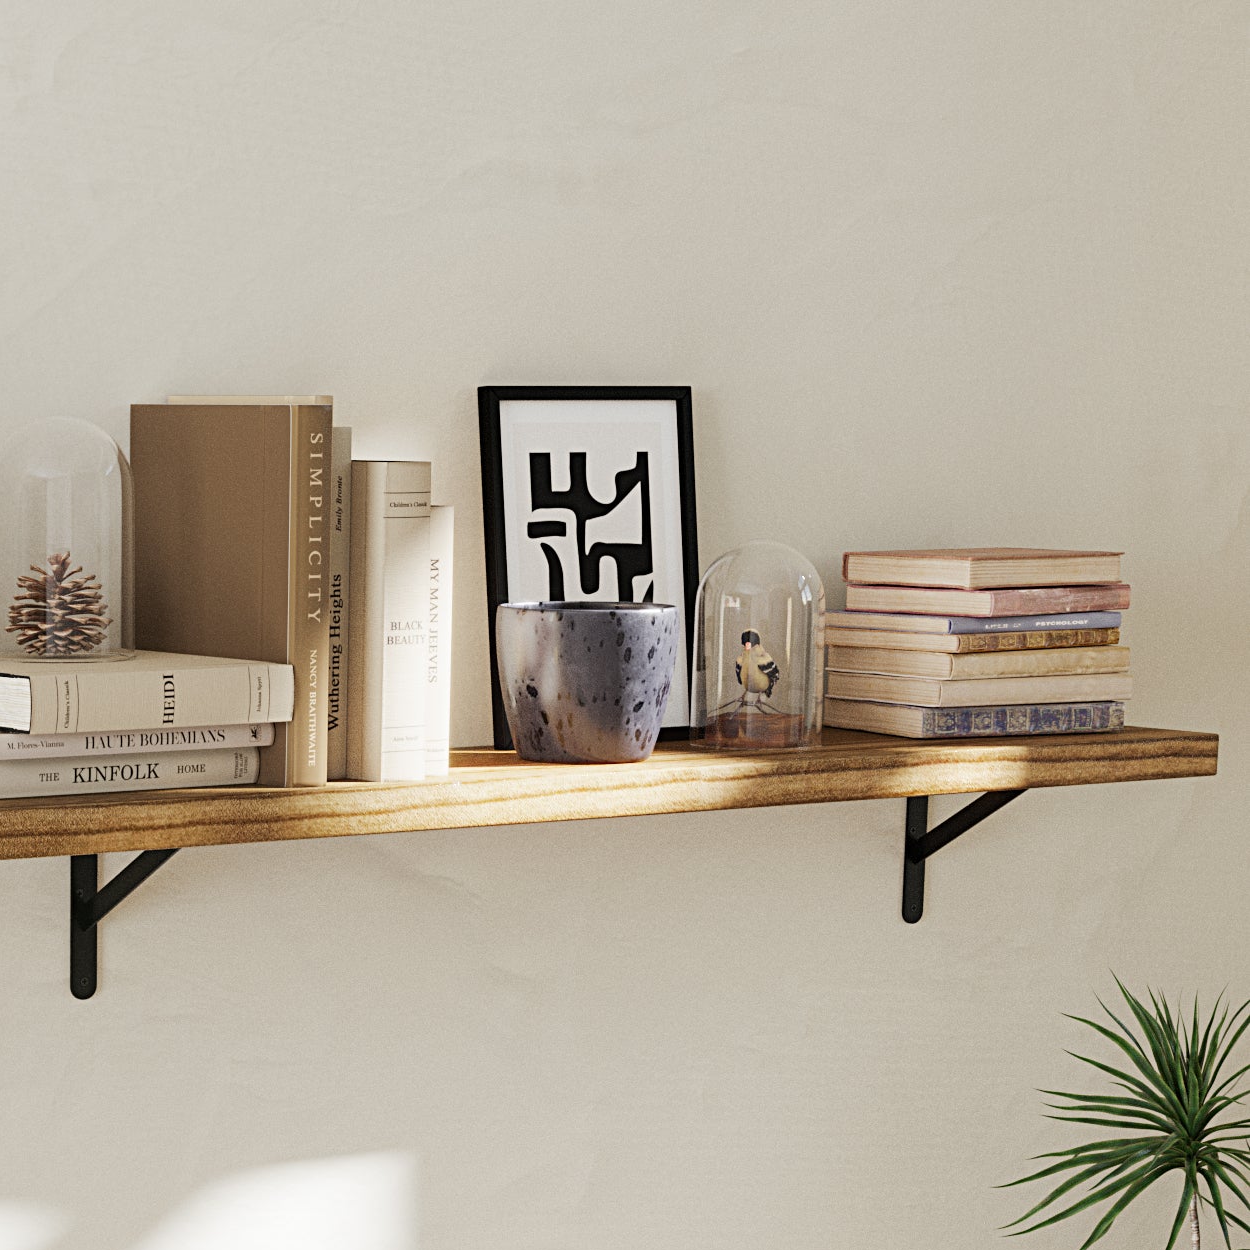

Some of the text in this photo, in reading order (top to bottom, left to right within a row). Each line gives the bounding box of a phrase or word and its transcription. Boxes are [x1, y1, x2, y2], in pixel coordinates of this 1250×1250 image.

[308, 432, 323, 623] SIMPLICITY
[335, 508, 343, 532] Emily
[390, 621, 423, 632] BLACK
[429, 558, 439, 683] MY MAN JEEVES
[387, 633, 426, 646] BEAUTY
[328, 574, 343, 731] Wuthering Heights
[162, 673, 174, 724] HEIDI
[308, 649, 317, 767] NANCY BRAITHWAITE
[7, 742, 16, 750] M.
[85, 729, 226, 750] HAUTE BOHEMIANS
[39, 762, 206, 783] THE KINFOLK HOME
